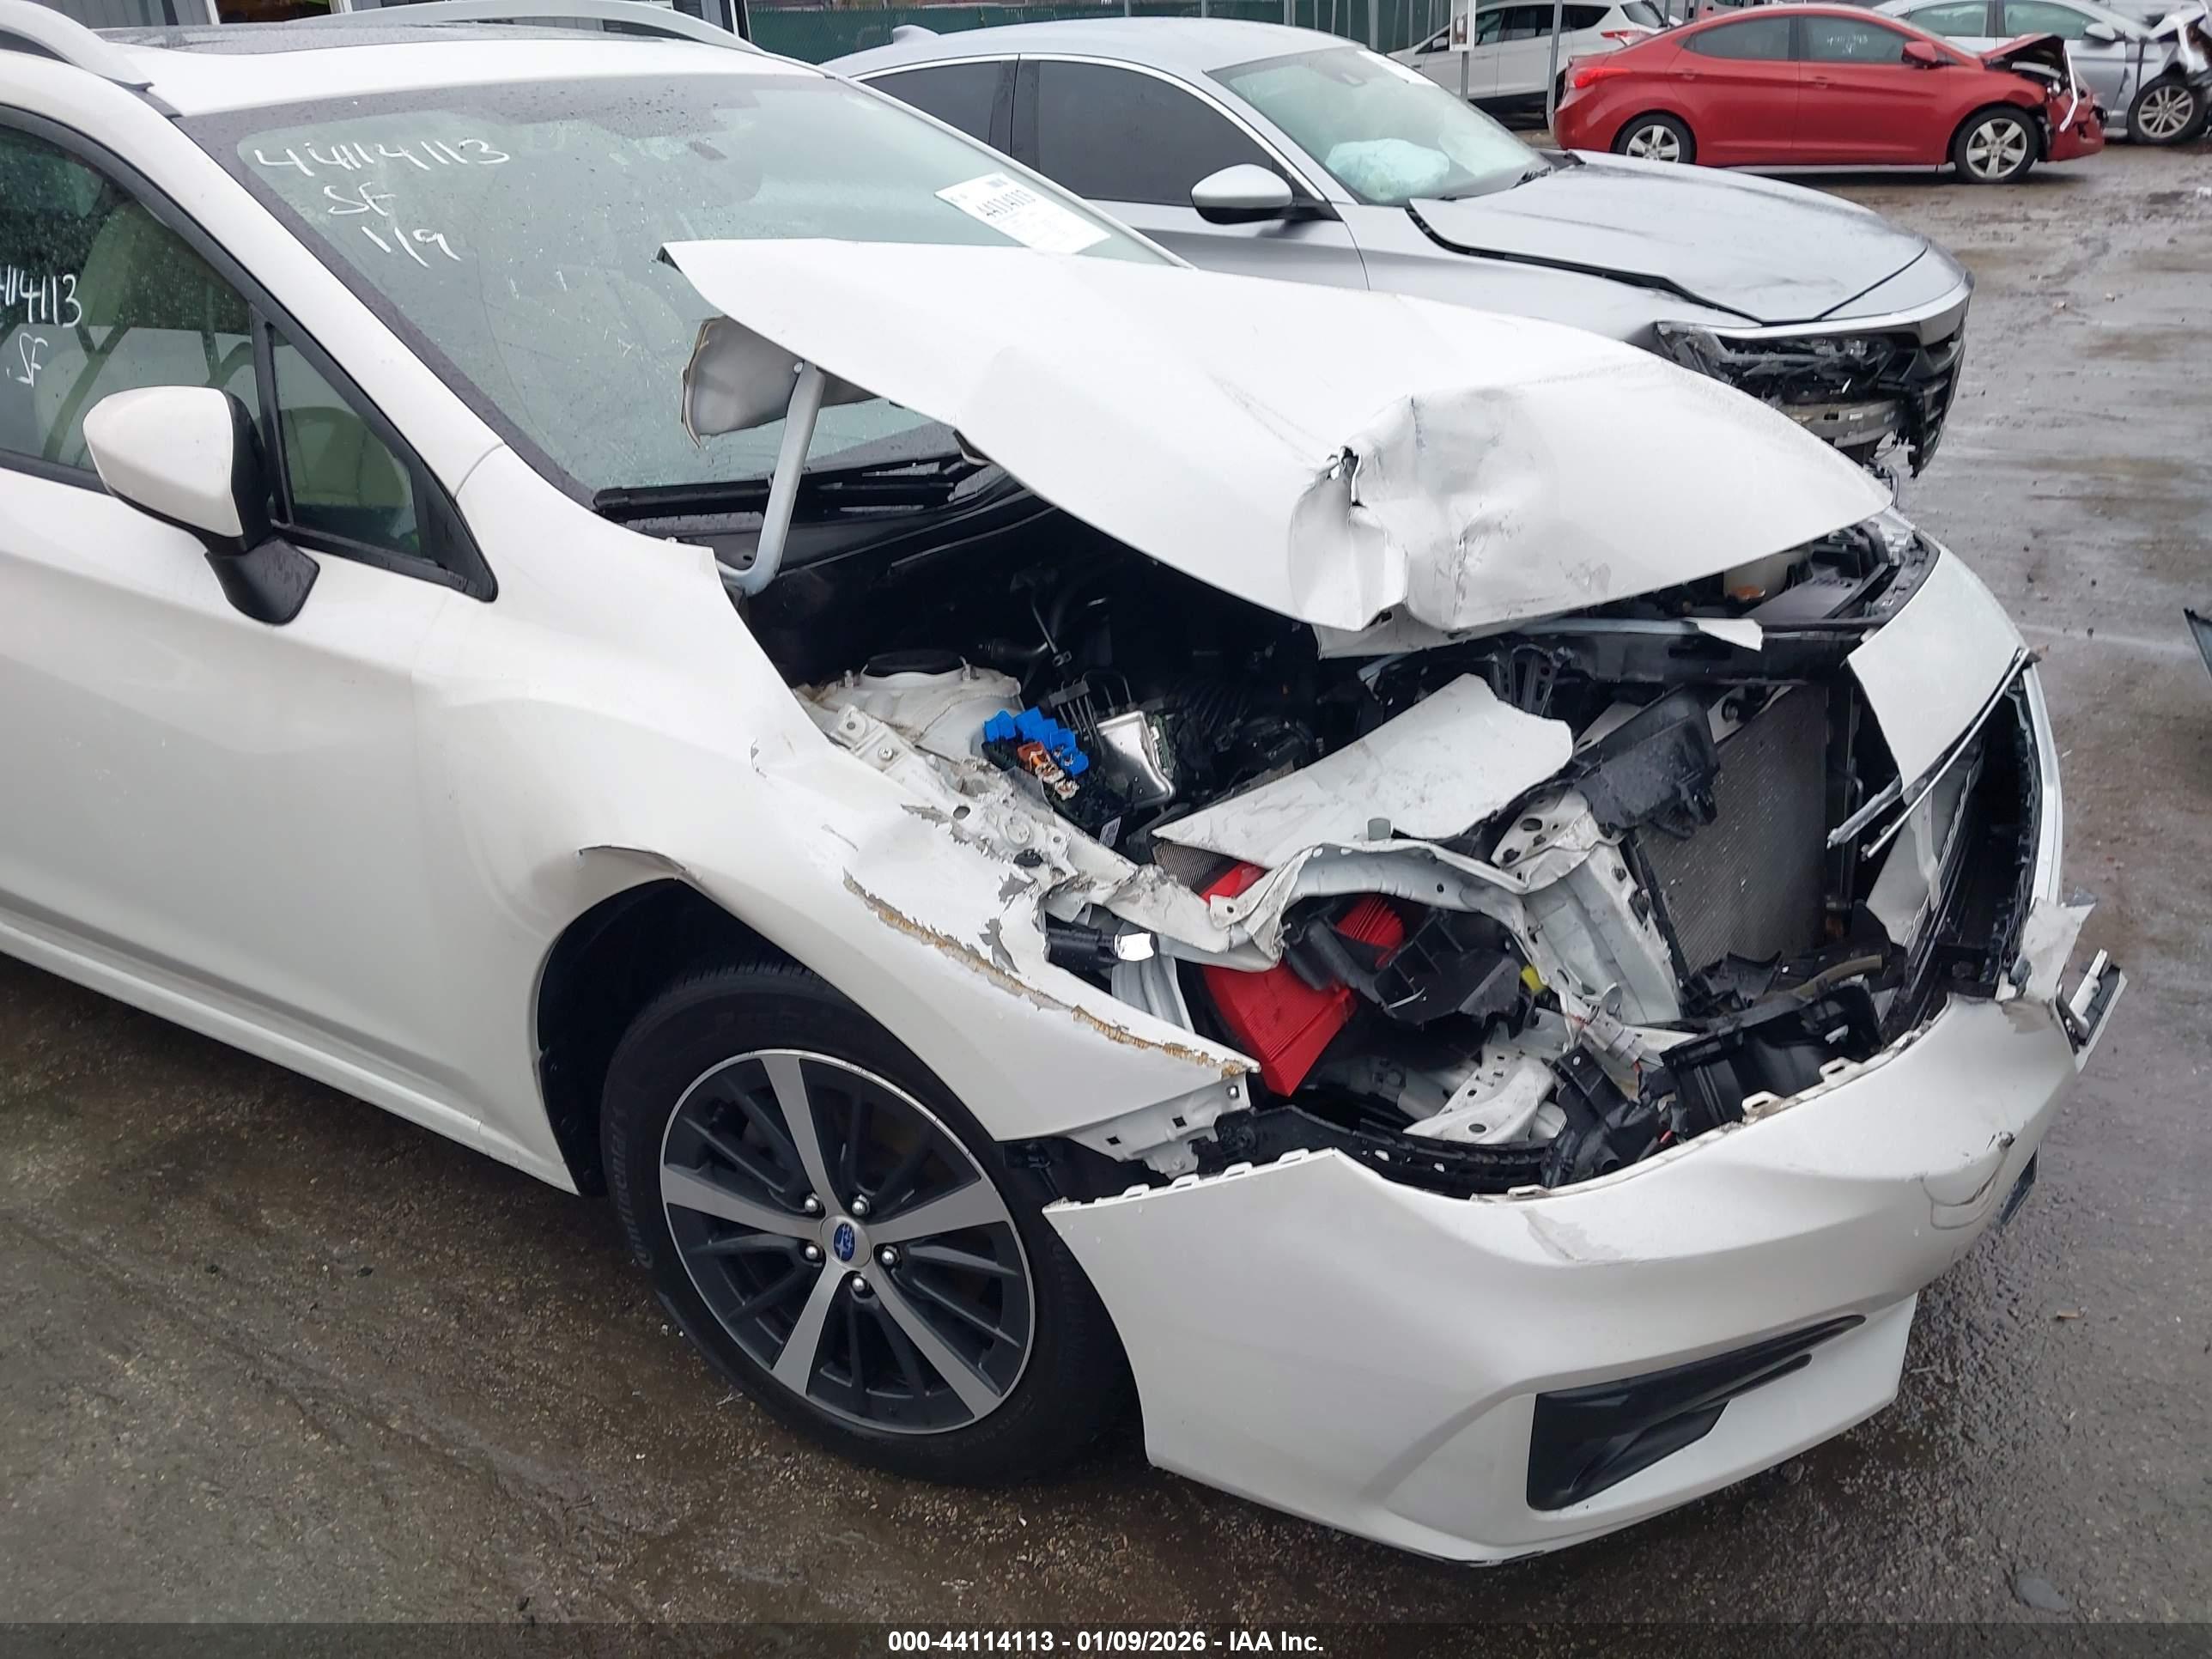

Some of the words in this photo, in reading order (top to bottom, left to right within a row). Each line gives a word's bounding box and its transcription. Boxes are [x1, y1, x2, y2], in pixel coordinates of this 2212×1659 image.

[254, 139, 510, 177] 44114113
[323, 181, 397, 216] SF
[0, 264, 82, 328] 114113
